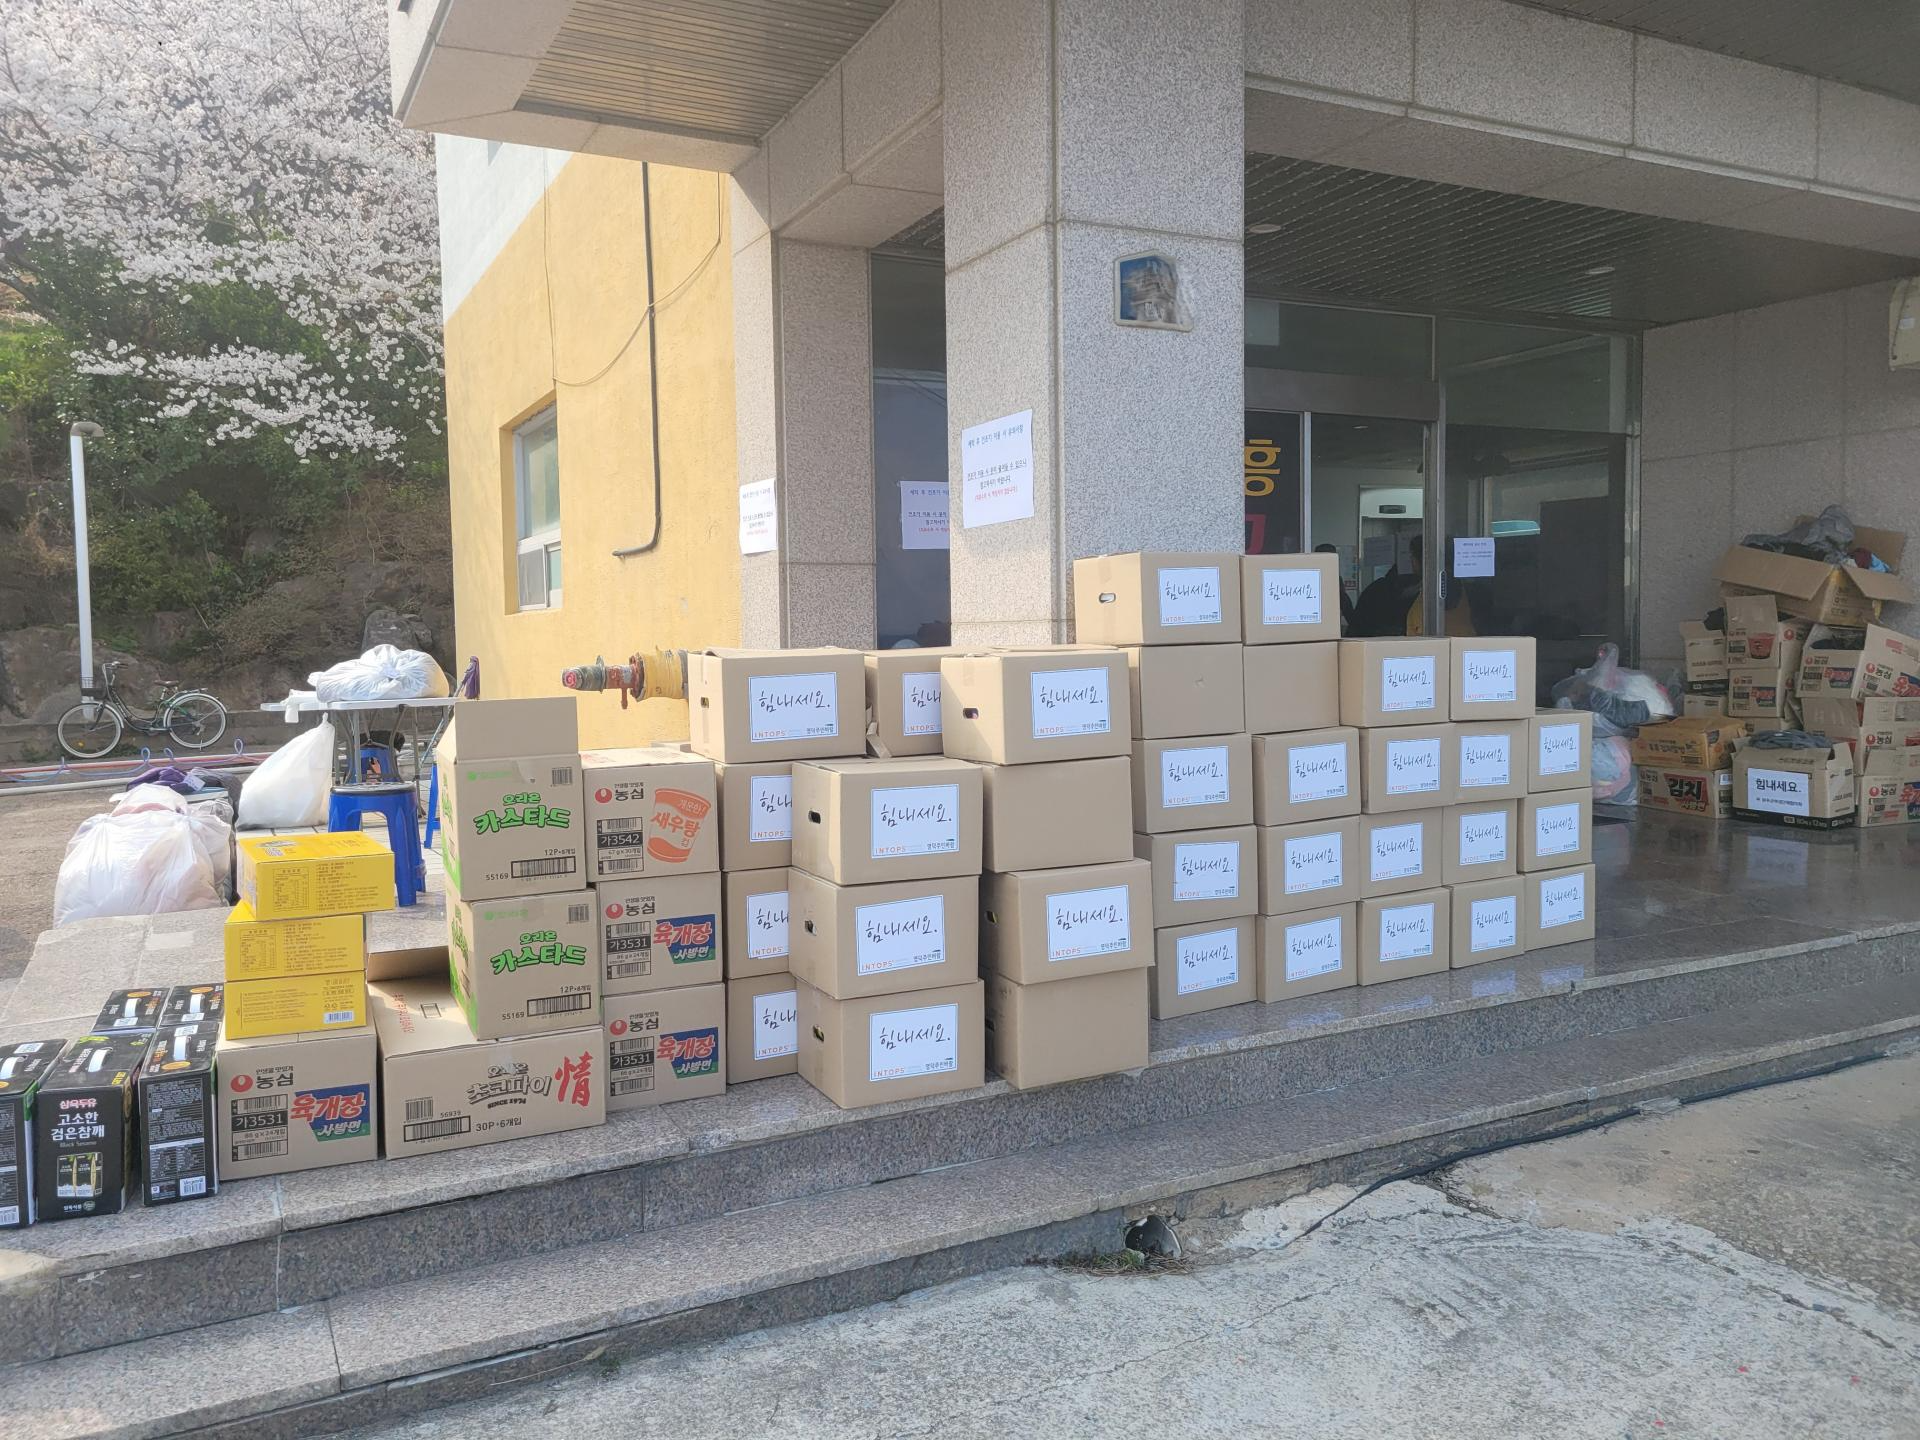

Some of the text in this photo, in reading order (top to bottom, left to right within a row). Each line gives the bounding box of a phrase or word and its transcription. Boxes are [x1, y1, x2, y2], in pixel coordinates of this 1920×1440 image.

[1876, 667, 1892, 680] 농심
[759, 690, 830, 712] 힘내세요.
[1040, 686, 1102, 708] 힘내세요.
[755, 729, 787, 738] INTOPS
[906, 724, 935, 733] INTOPS
[1036, 725, 1064, 734] INTOPS
[1876, 735, 1892, 744] 농심
[1668, 778, 1702, 800] 김치
[1756, 778, 1801, 793] 힘내세요.
[1881, 787, 1897, 796] 농심
[503, 792, 541, 806] 오리온
[615, 788, 644, 801] 농심
[473, 805, 571, 835] 카스타드
[881, 804, 951, 827] 힘내세요.
[650, 812, 701, 838] 새우탕
[600, 834, 640, 846] 가3542
[754, 831, 785, 839] INTOPS
[876, 844, 908, 854] INTOPS
[486, 873, 509, 881] 55169
[626, 902, 655, 916] 농심
[1056, 905, 1122, 930] 힘내세요.
[653, 921, 712, 947] 육개장
[866, 916, 937, 943] 힘내세요.
[520, 931, 557, 945] 오리온
[610, 939, 647, 950] 가3531
[674, 946, 709, 960] 사발면
[752, 947, 783, 956] INTOPS
[1051, 945, 1081, 956] INTOPS
[490, 943, 587, 975] 카스타드
[861, 960, 893, 971] INTOPS
[502, 1012, 525, 1020] 55169
[630, 1018, 659, 1032] 농심
[880, 1024, 950, 1050] 힘내세요.
[656, 1035, 715, 1061] 육개장
[758, 1046, 788, 1056] INTOPS
[614, 1054, 650, 1066] 가3531
[676, 1059, 712, 1074] 사발면
[873, 1066, 905, 1076] INTOPS
[256, 1073, 293, 1089] 농심
[555, 1051, 593, 1107] 情
[466, 1074, 552, 1104] 초코파이
[290, 1092, 366, 1122] 육개장
[57, 1112, 99, 1125] 고소한
[235, 1114, 282, 1128] 가3531
[51, 1125, 104, 1140] 검은참깨
[317, 1120, 361, 1136] 사발면
